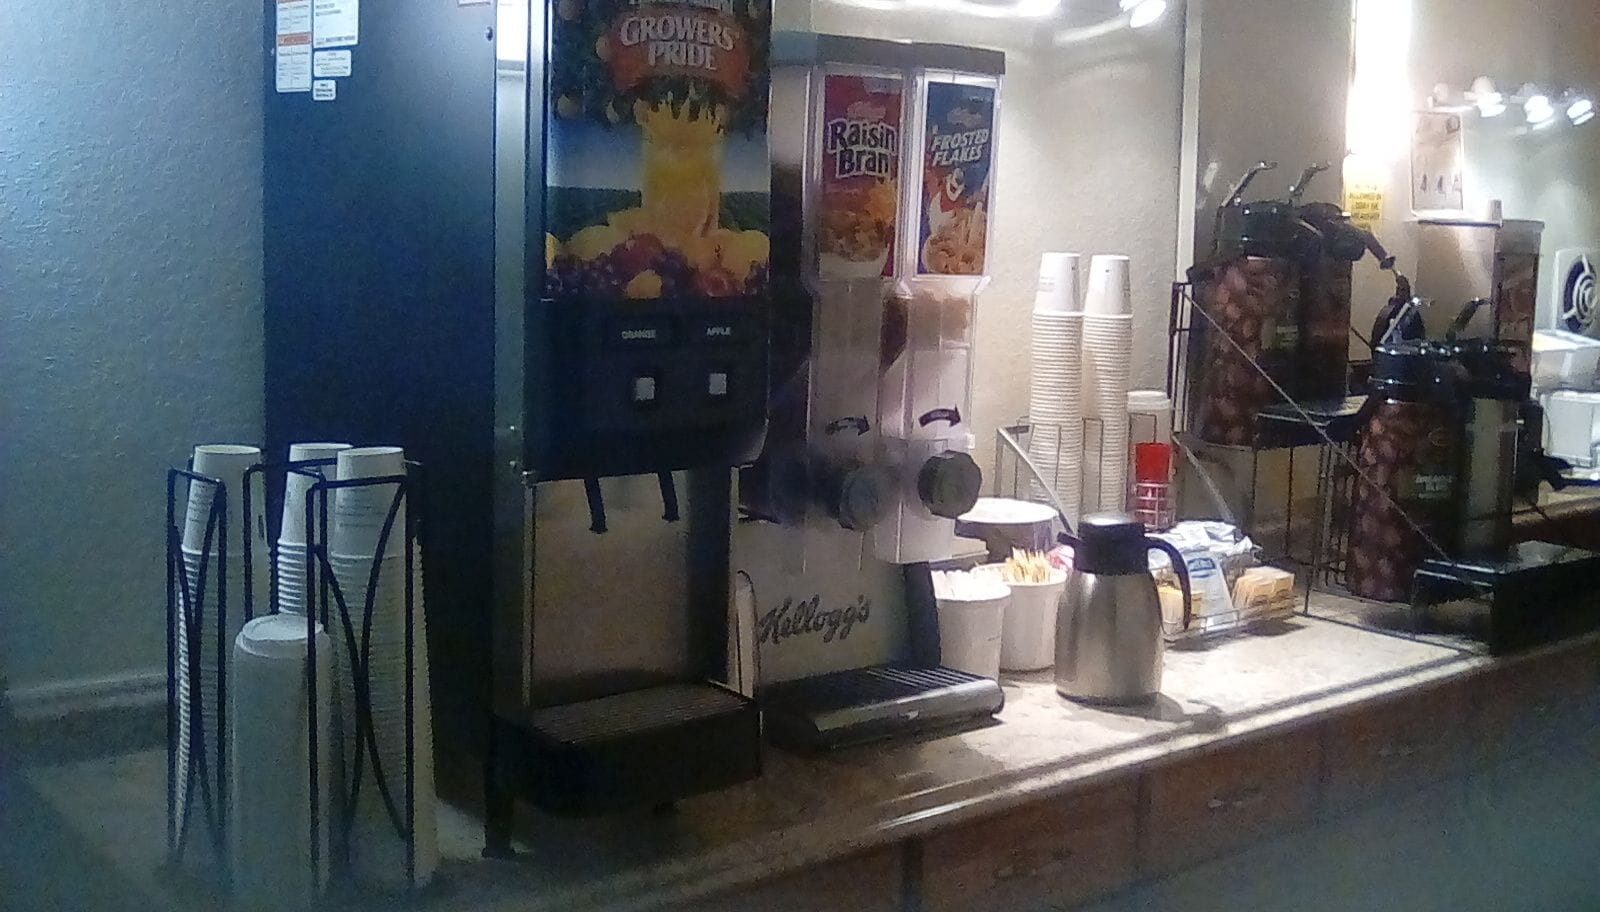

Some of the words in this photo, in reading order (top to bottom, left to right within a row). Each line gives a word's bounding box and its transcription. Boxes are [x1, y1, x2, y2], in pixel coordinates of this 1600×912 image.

[620, 15, 734, 51] GROWERS
[648, 40, 717, 71] PRIDE
[827, 117, 899, 154] Raisin
[932, 128, 990, 151] FROSTED
[835, 147, 891, 179] Bran
[932, 146, 983, 168] FLAKES
[621, 329, 657, 339] ORANGE
[706, 327, 731, 336] APPLE
[759, 594, 870, 643] Kellogg's
